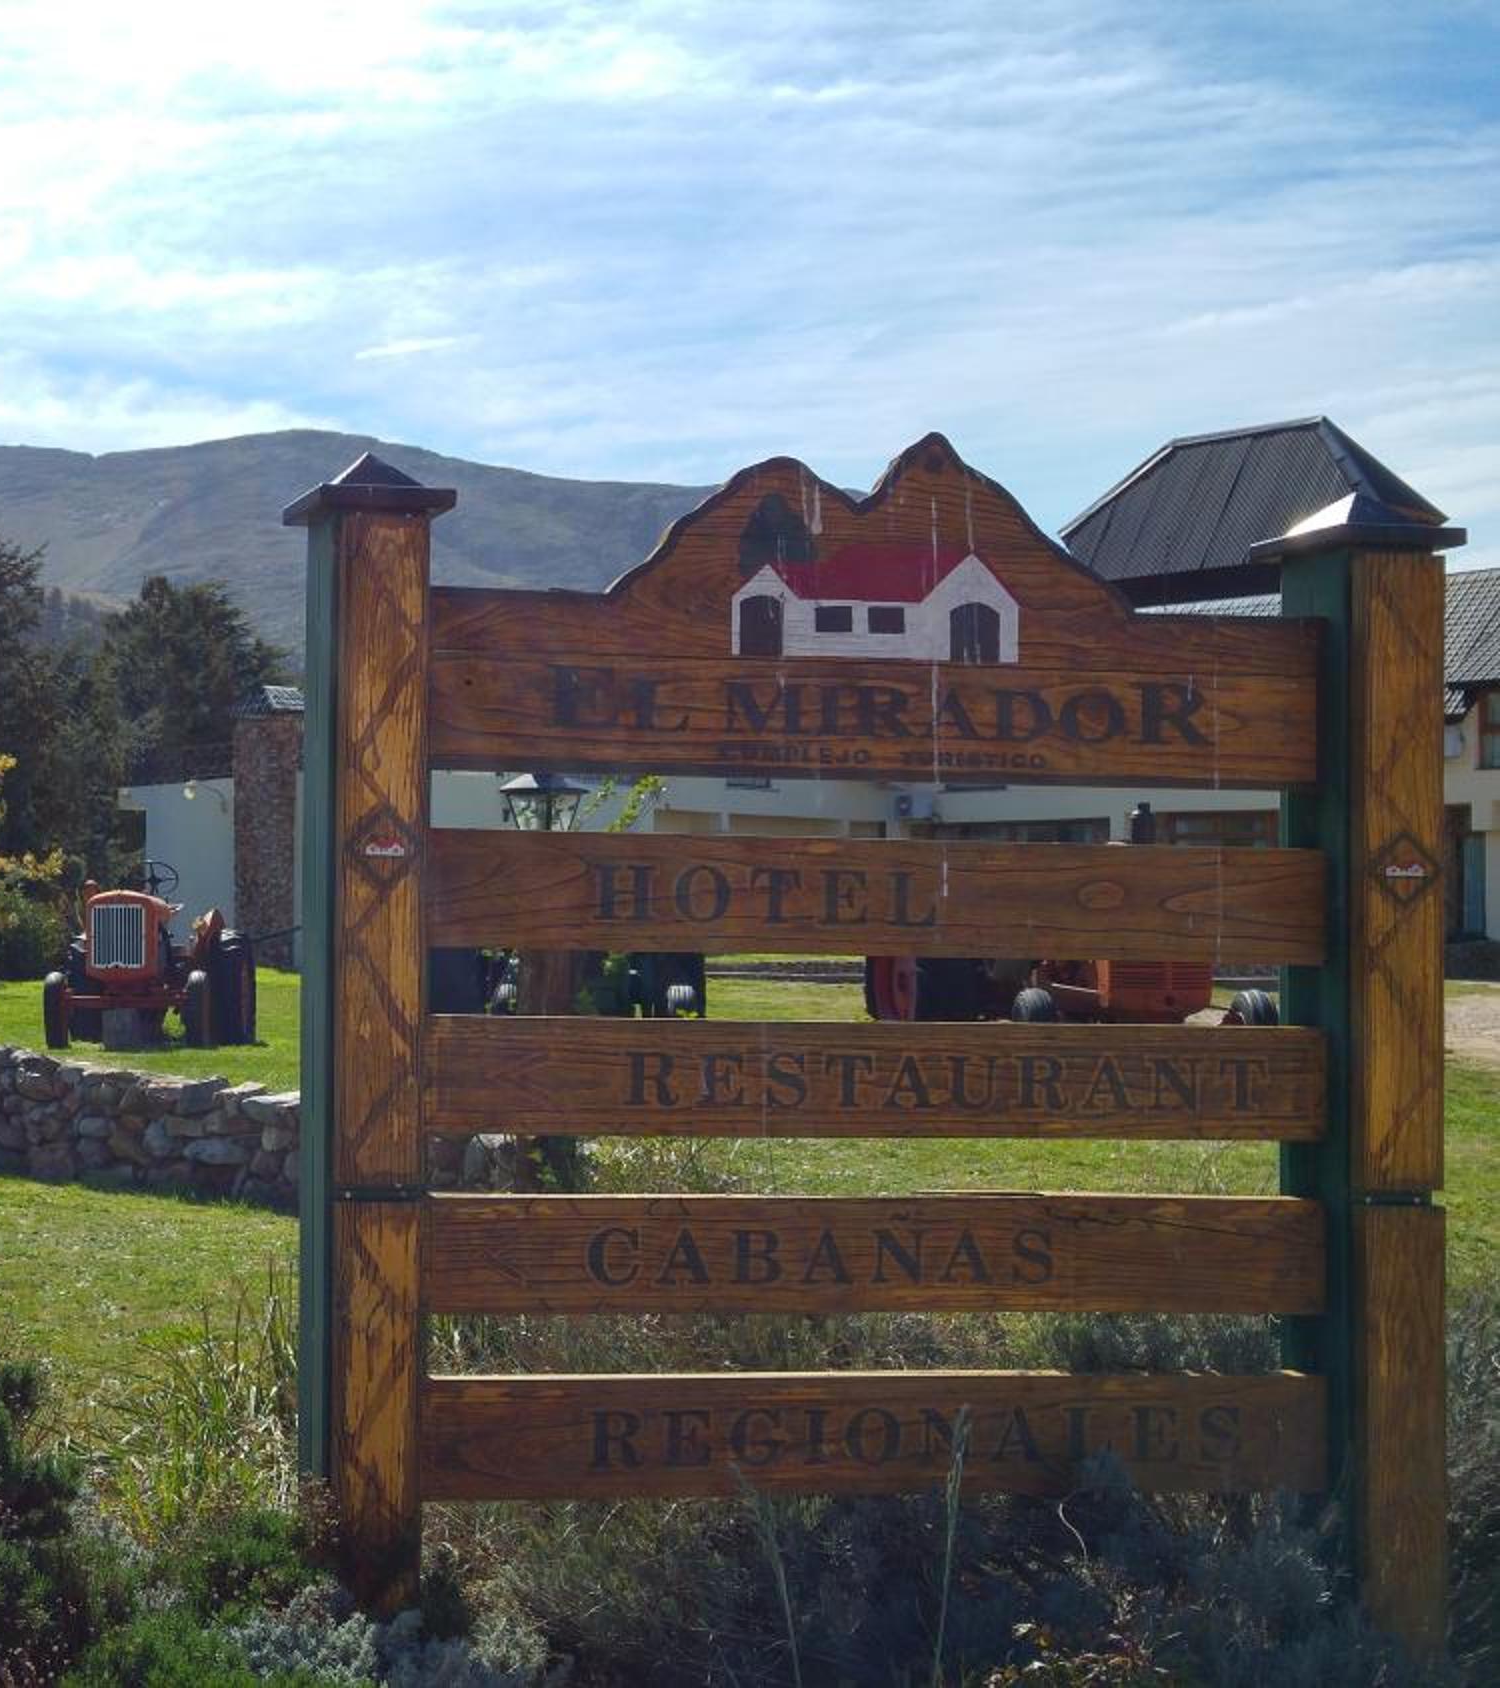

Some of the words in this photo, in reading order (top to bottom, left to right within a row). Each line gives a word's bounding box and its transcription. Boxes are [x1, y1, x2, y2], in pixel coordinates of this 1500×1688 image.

[549, 665, 684, 731] EL
[724, 680, 1215, 745] MIRADOR
[593, 863, 937, 928] HOTEL
[625, 1050, 1269, 1111] RESTAURANT
[587, 1211, 1055, 1287] CABAÑAS
[587, 1405, 1243, 1470] REGIONALES
